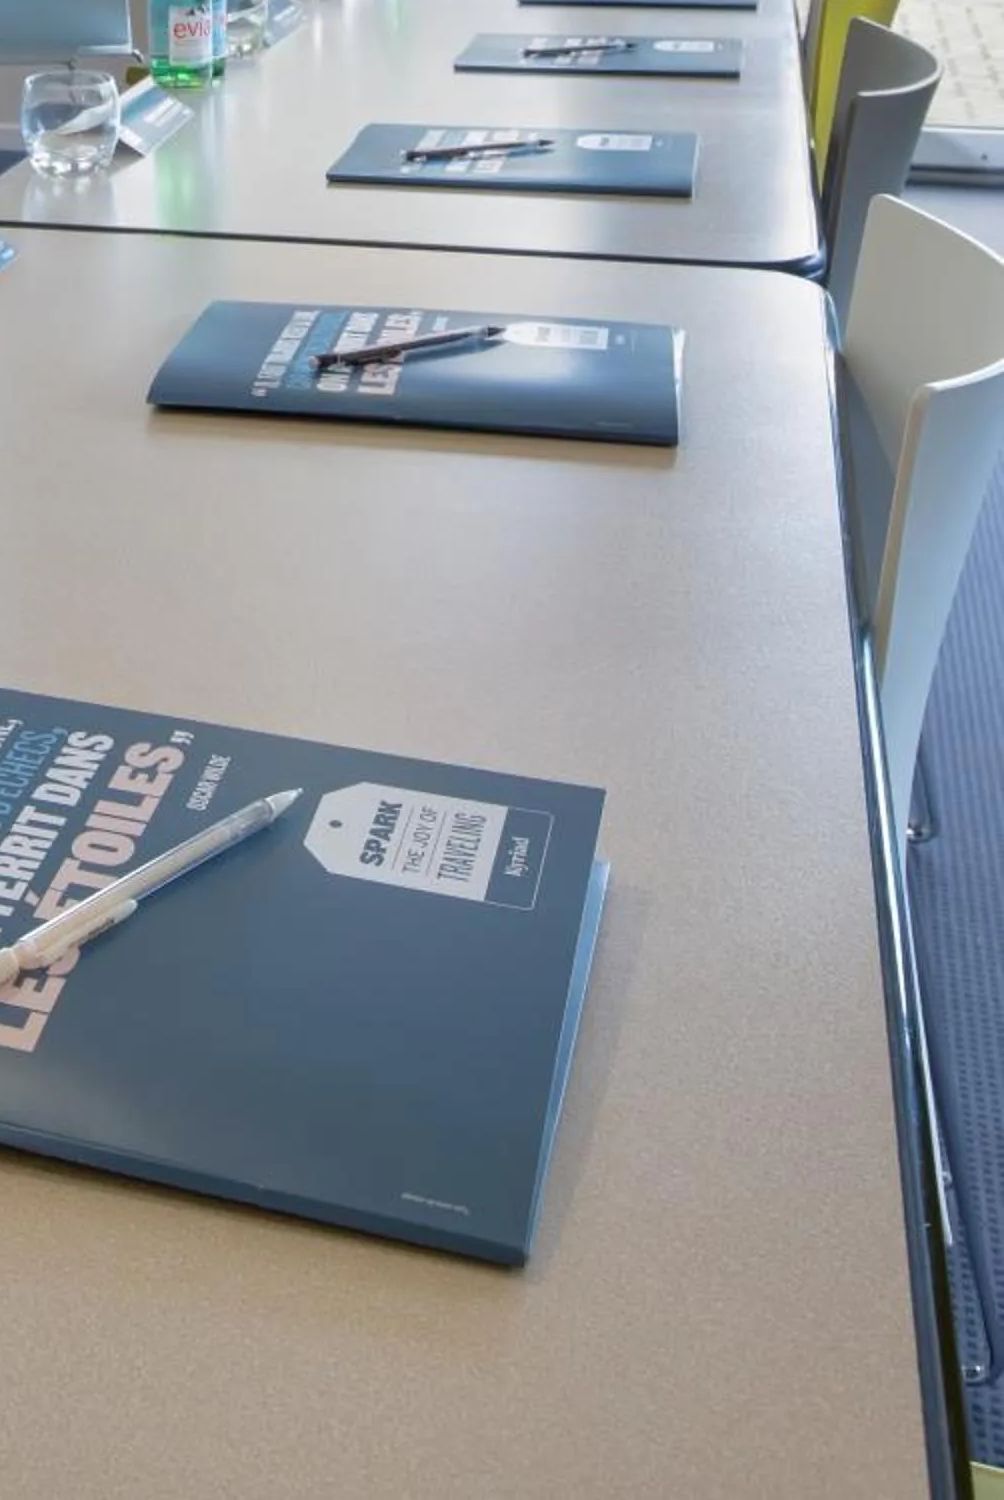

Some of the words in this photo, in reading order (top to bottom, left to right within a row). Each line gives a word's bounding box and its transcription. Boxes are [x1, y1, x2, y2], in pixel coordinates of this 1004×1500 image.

[30, 731, 114, 807] DANS
[360, 800, 402, 868] SPARK
[412, 823, 434, 849] JOY
[420, 805, 439, 822] OF
[402, 848, 424, 874] THE
[436, 812, 487, 883] TRAVELING
